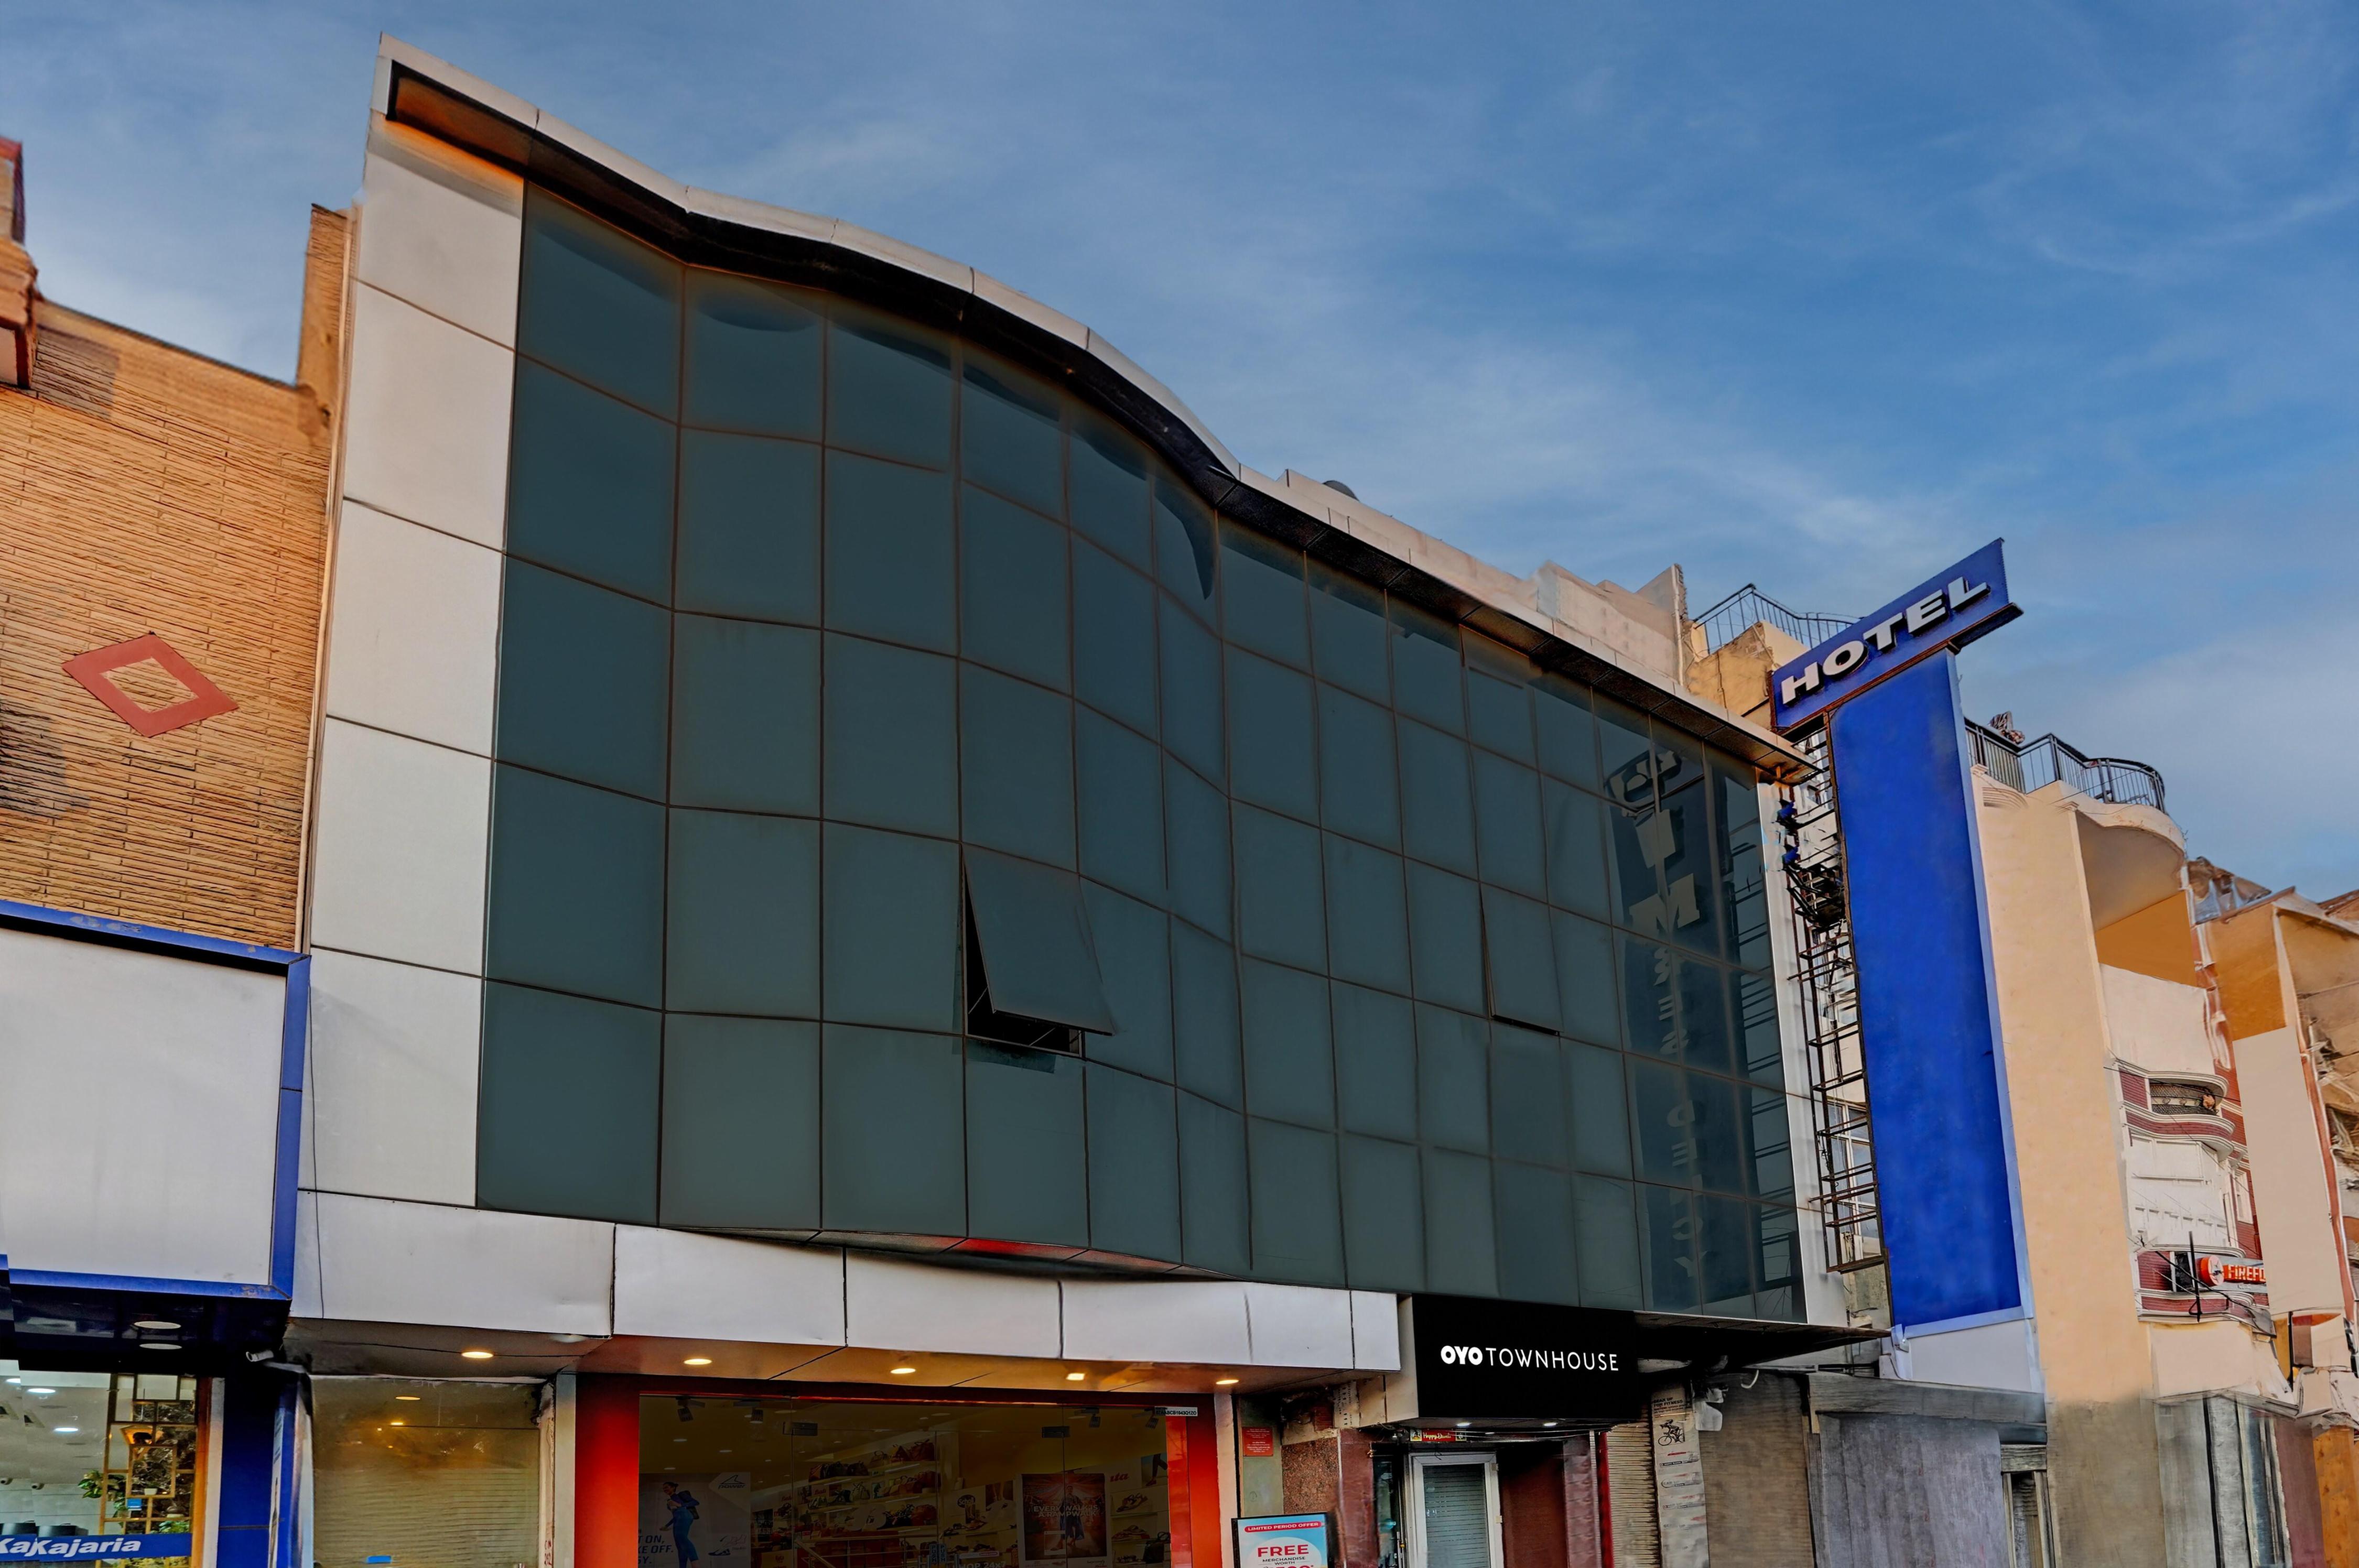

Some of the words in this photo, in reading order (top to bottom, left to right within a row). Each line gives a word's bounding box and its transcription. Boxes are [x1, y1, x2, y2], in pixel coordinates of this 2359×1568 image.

[1781, 576, 1990, 705] HOTEL
[1441, 1345, 1483, 1366] OYO
[1485, 1347, 1619, 1371] TOWNHOUSE
[37, 1538, 141, 1558] Kajaria
[1258, 1544, 1309, 1558] FREE
